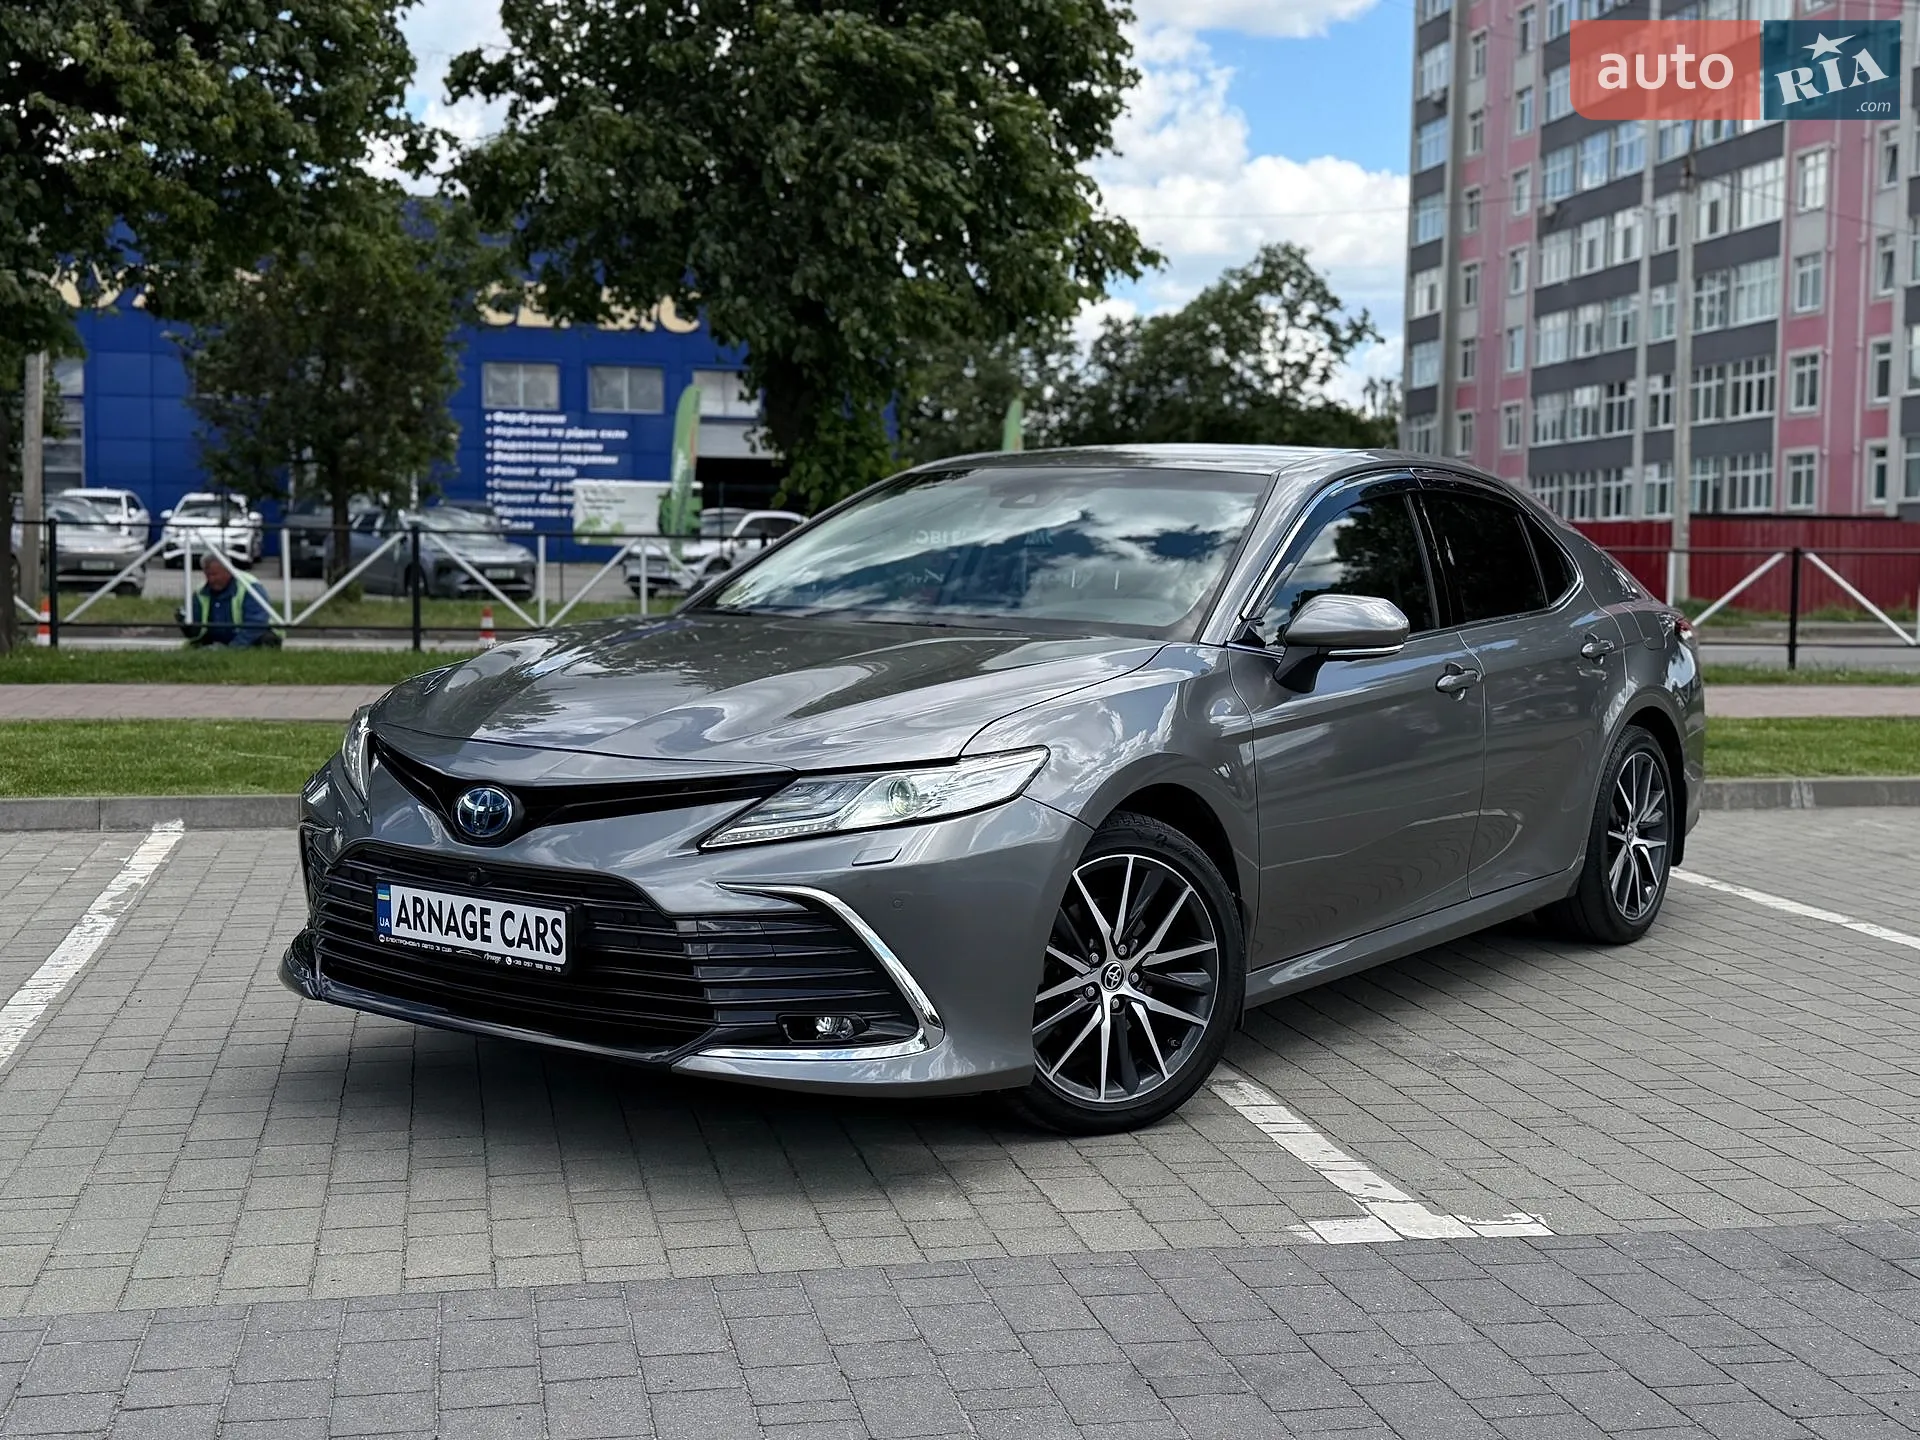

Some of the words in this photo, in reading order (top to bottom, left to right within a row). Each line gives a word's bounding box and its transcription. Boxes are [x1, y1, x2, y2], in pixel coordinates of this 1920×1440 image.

[379, 917, 390, 928] UA
[395, 894, 492, 944] ARNAGE
[500, 910, 564, 957] CARS
